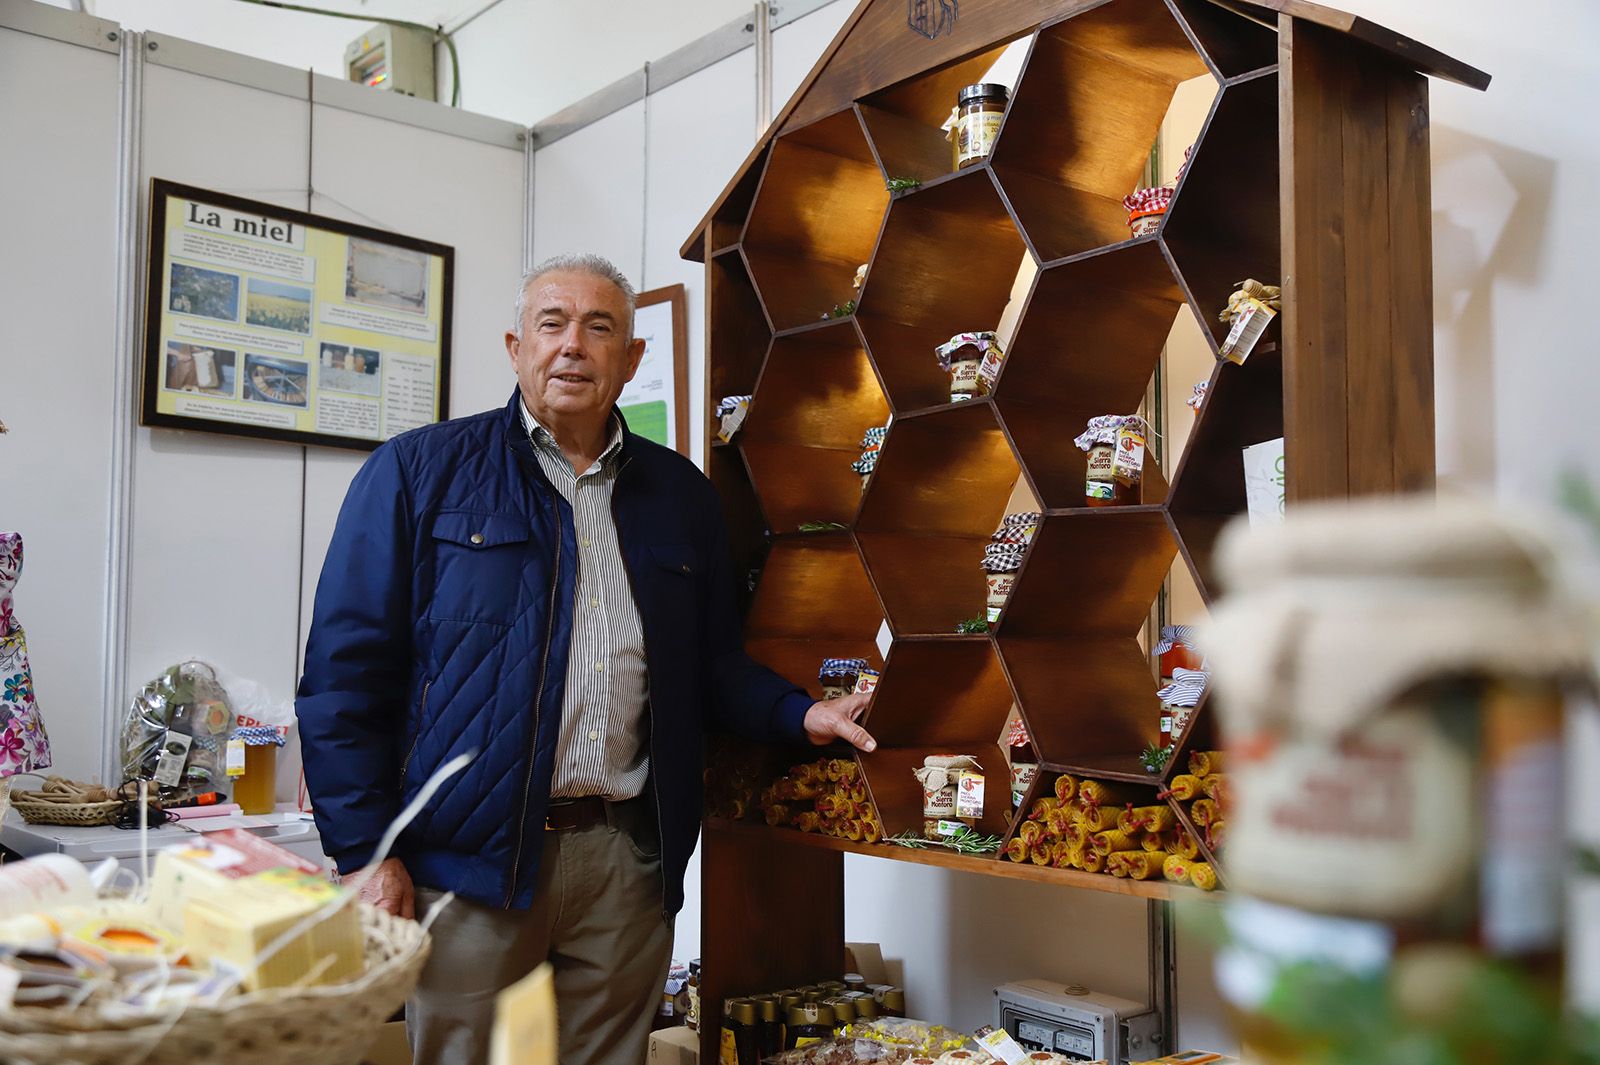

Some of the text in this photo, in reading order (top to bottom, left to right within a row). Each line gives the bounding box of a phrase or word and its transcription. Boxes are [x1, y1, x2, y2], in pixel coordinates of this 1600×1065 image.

[189, 202, 293, 243] La miel
[1090, 462, 1111, 470] Montoro
[936, 796, 953, 804] Sierra
